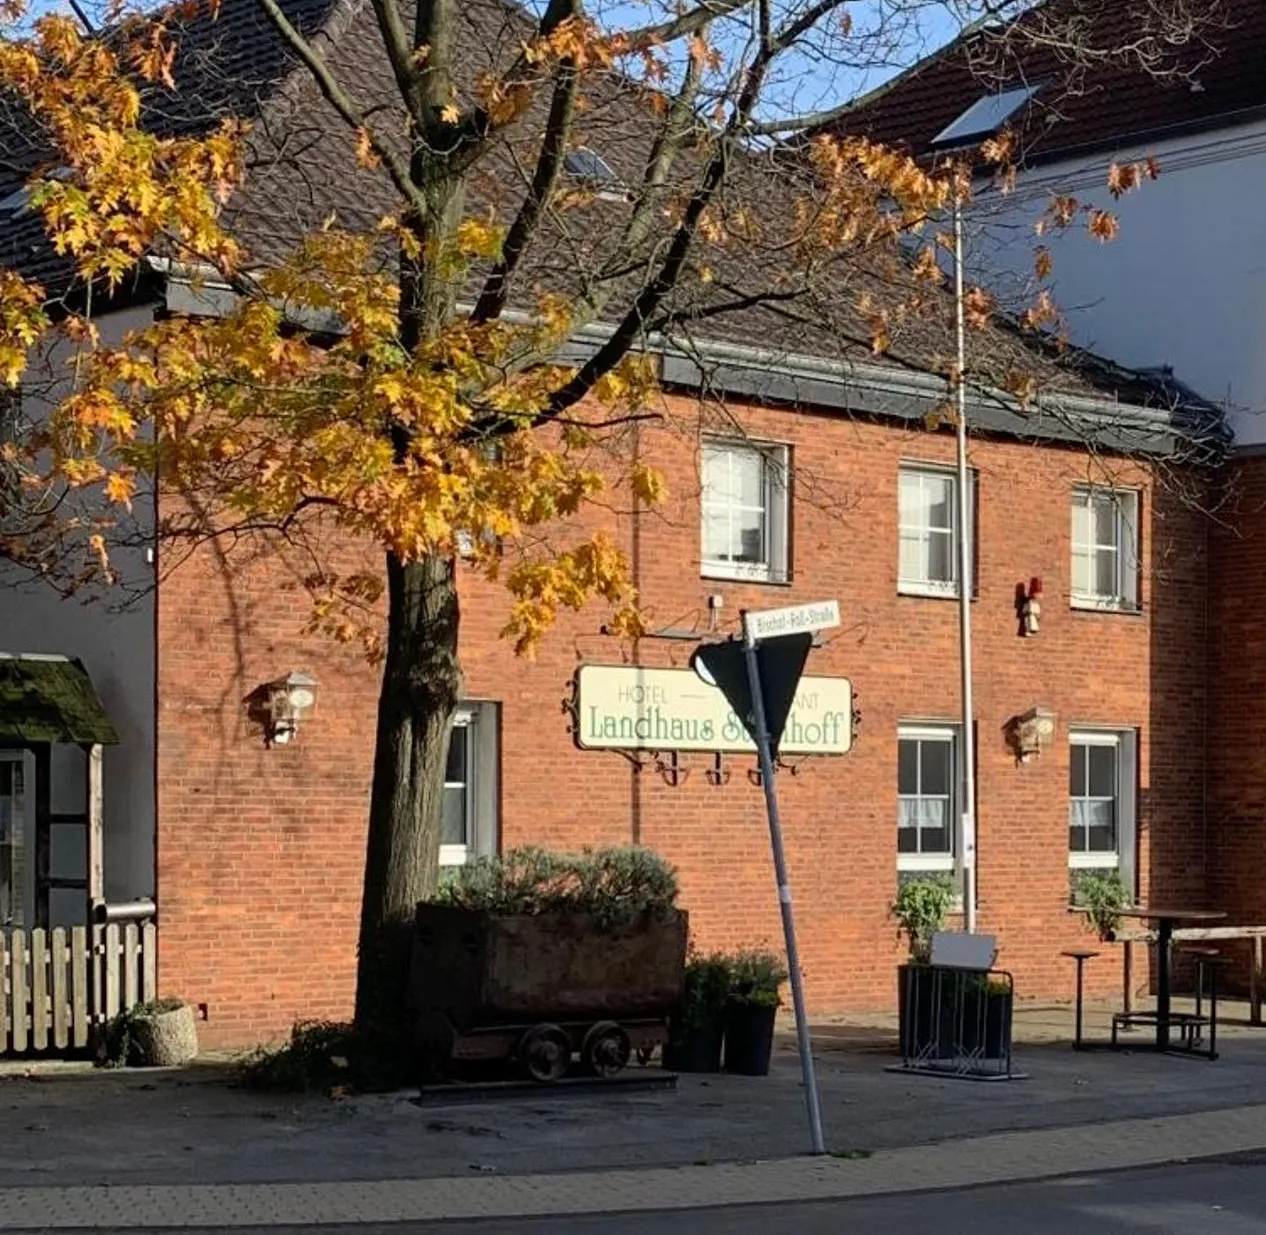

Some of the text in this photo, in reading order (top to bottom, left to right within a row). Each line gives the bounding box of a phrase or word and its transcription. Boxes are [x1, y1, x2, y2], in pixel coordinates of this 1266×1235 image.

[617, 685, 668, 704] HOTEL
[589, 706, 844, 745] Landhaus Shoff
